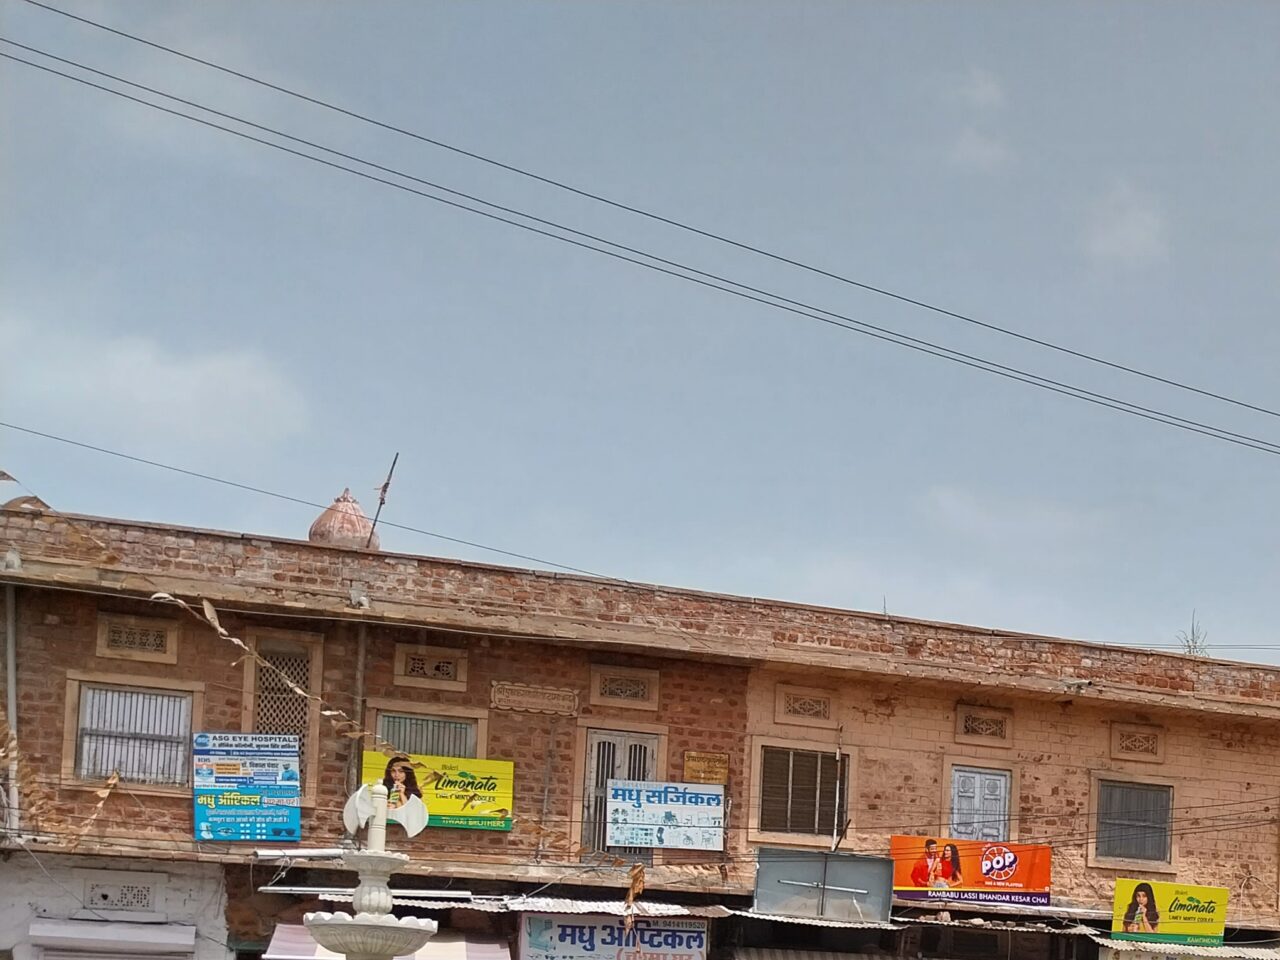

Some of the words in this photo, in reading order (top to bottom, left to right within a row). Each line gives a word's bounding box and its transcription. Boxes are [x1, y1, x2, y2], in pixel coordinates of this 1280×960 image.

[435, 772, 498, 791] Limonata
[197, 794, 215, 808] मधु
[611, 787, 643, 808] मधु
[645, 785, 723, 806] सर्जिकल
[982, 851, 1016, 874] POP
[928, 890, 959, 899] RAMBABU
[960, 891, 978, 900] LASSI
[979, 893, 1010, 901] BHANDAR
[1011, 895, 1031, 903] KESAR
[1168, 897, 1217, 914] Limonata
[557, 924, 597, 952] मधु
[601, 918, 706, 950] ऑप्टिकल
